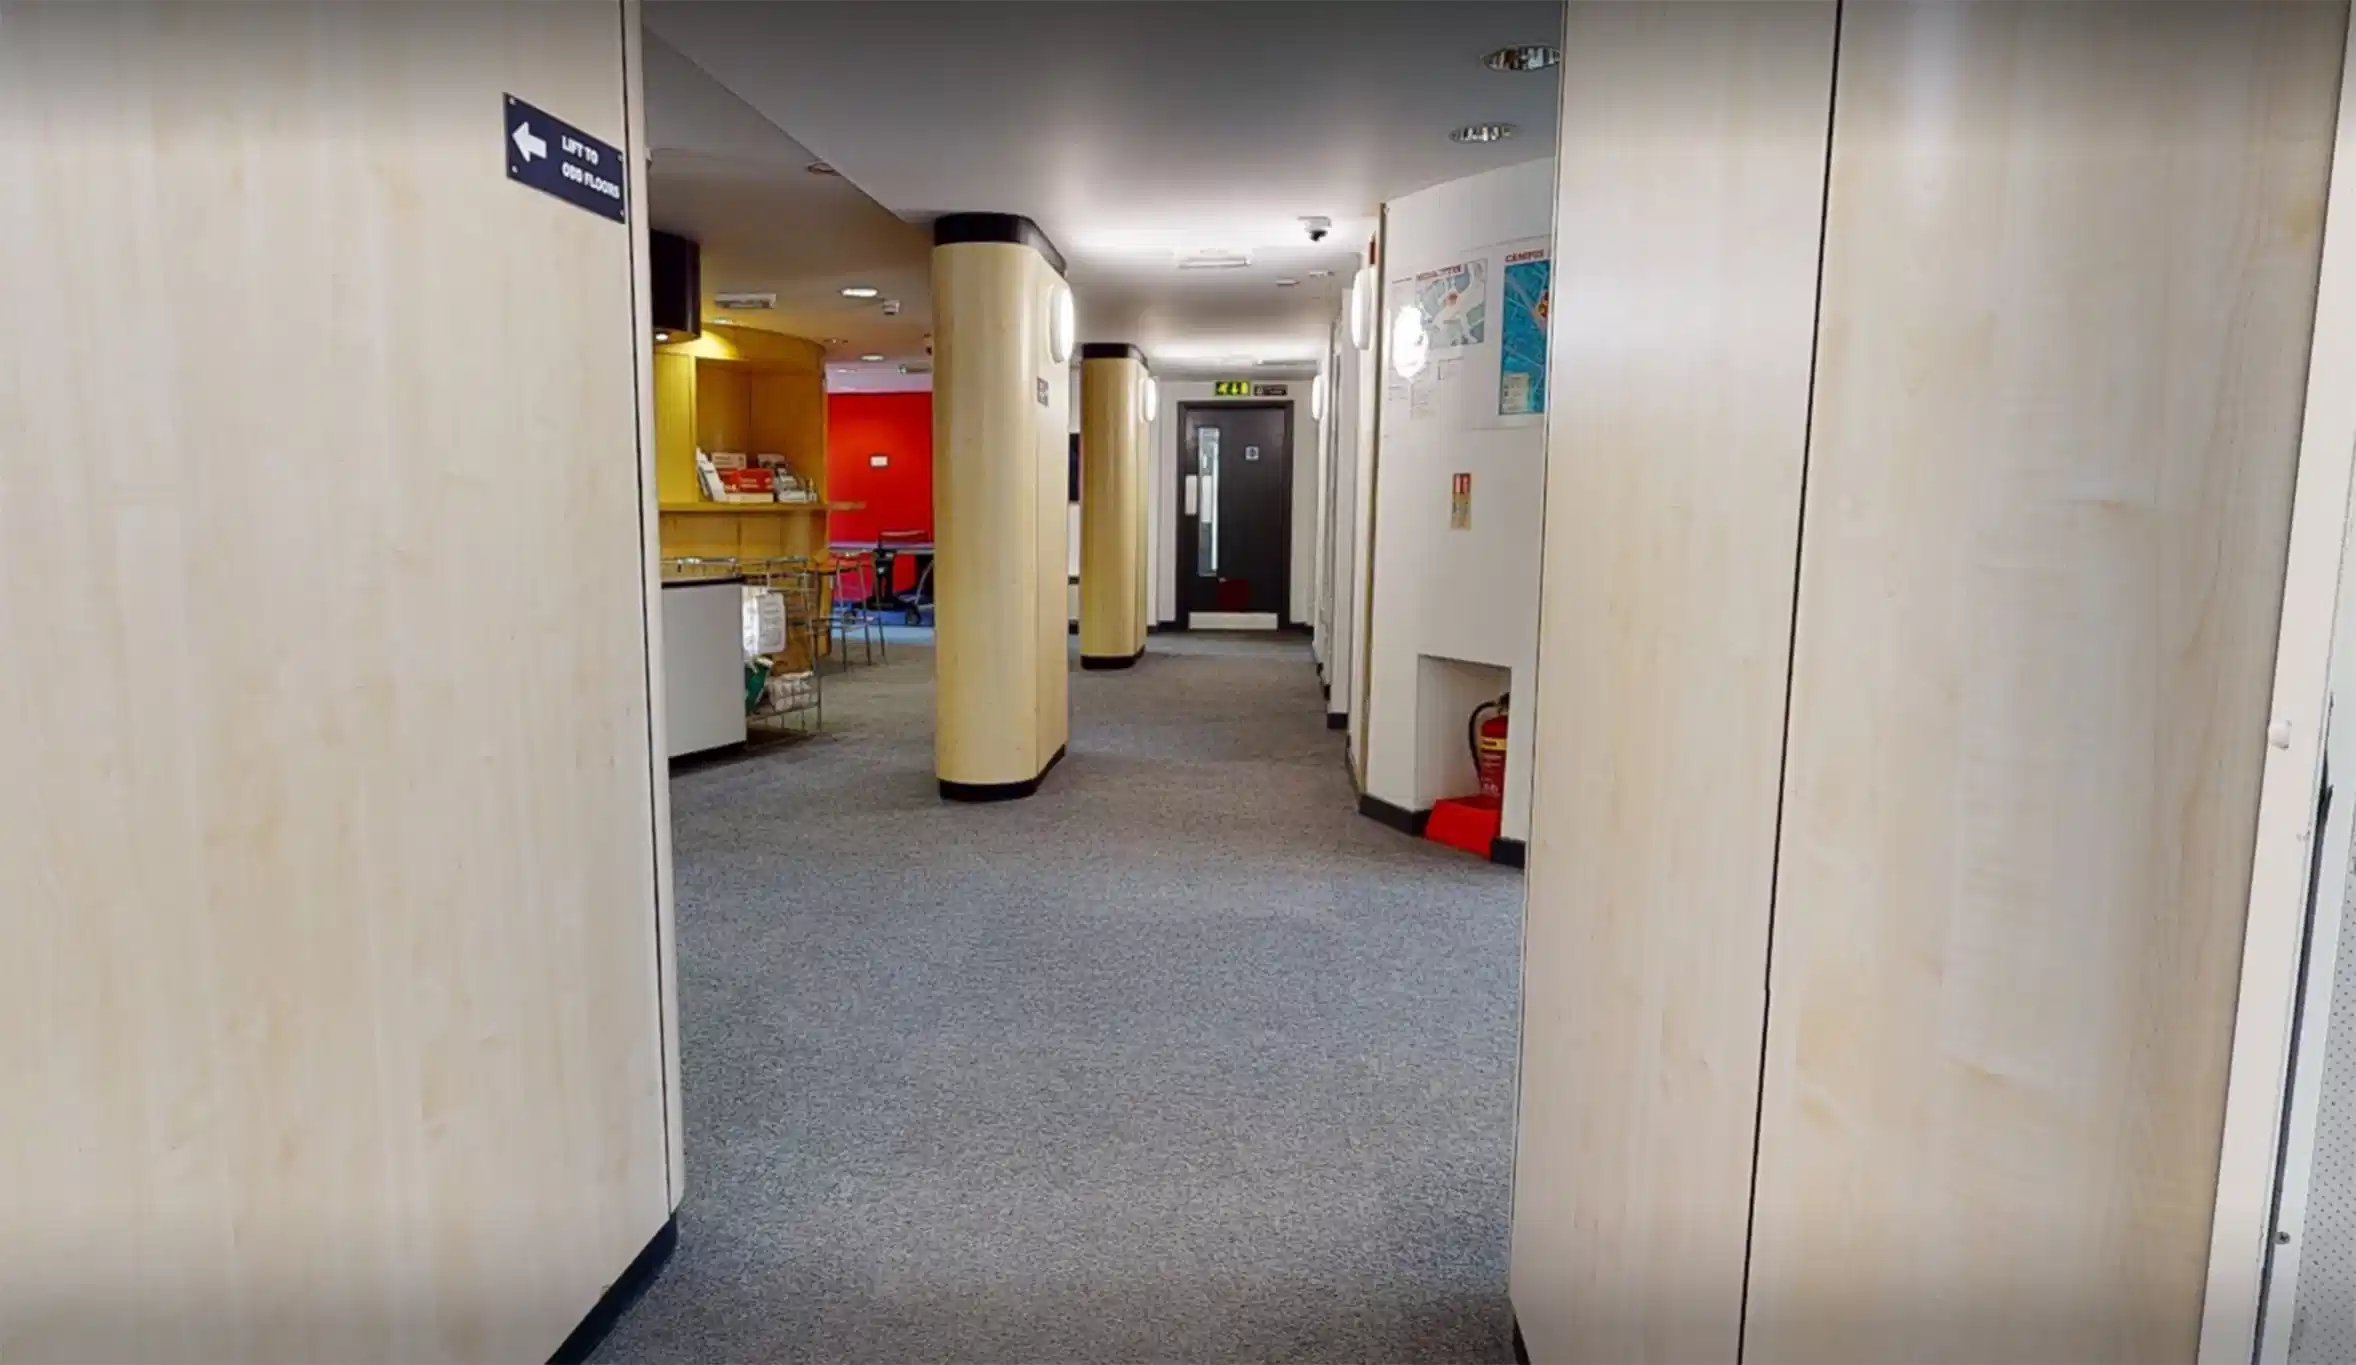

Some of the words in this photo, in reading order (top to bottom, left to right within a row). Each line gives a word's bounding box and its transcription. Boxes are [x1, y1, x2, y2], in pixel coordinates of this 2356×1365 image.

[561, 135, 583, 158] LIFT
[584, 146, 600, 165] TO
[561, 161, 583, 184] ODD
[584, 172, 621, 200] FLOORS
[1505, 248, 1545, 263] CAMPUS
